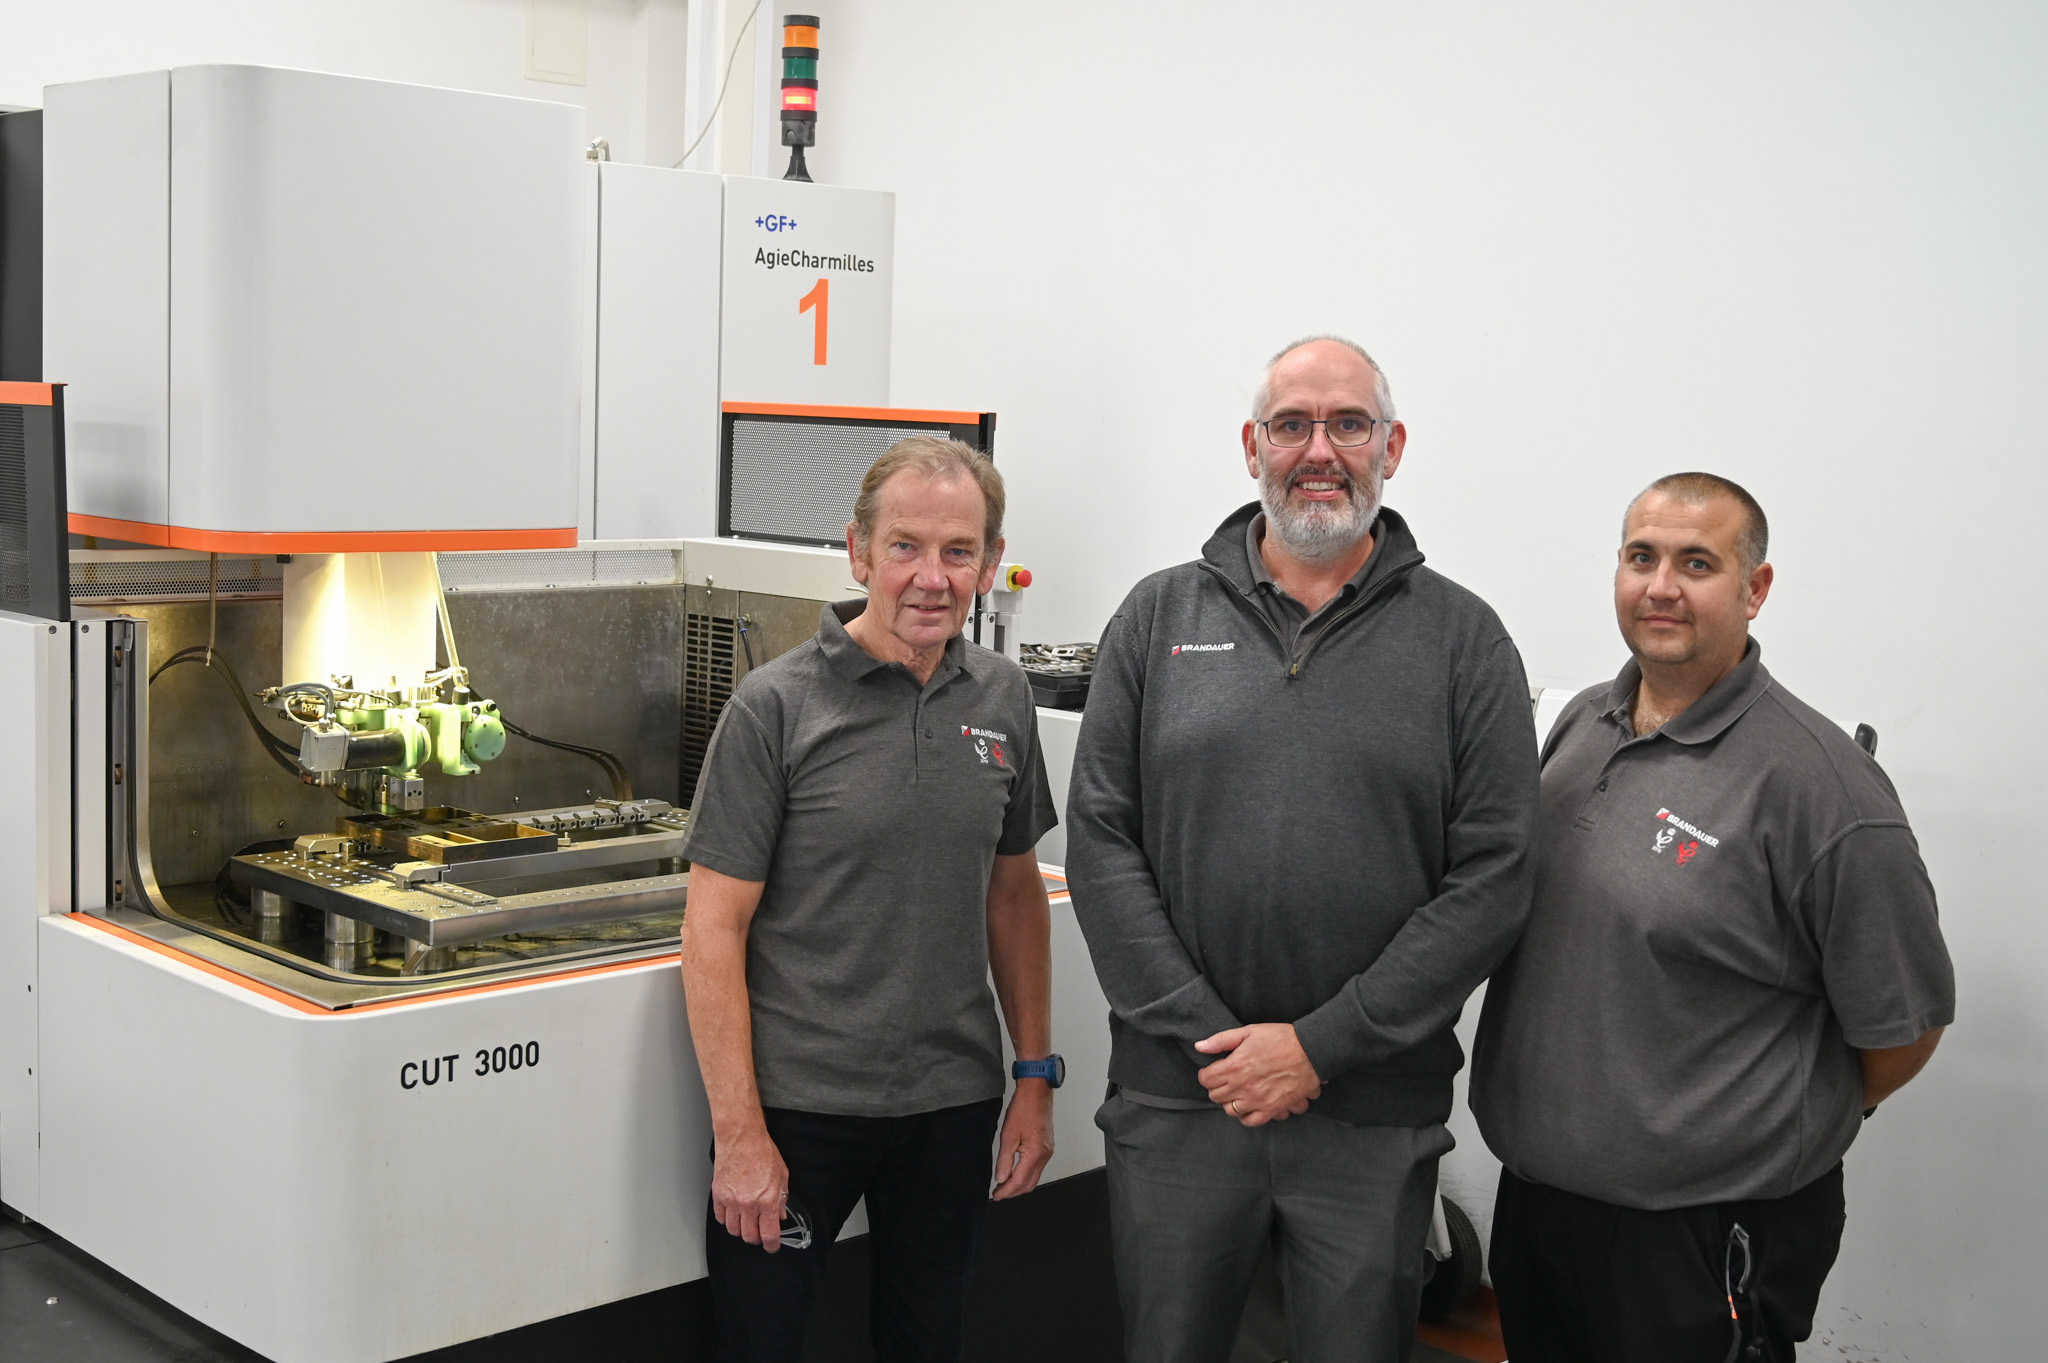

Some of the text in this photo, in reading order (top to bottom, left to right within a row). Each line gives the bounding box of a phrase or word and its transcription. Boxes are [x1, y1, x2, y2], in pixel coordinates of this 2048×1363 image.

[754, 247, 874, 273] AgieCharmilles
[799, 278, 829, 366] 1
[1181, 642, 1235, 652] BRANDAUER
[1666, 813, 1720, 848] BRANDAUER
[400, 1040, 540, 1090] CUT 3000
